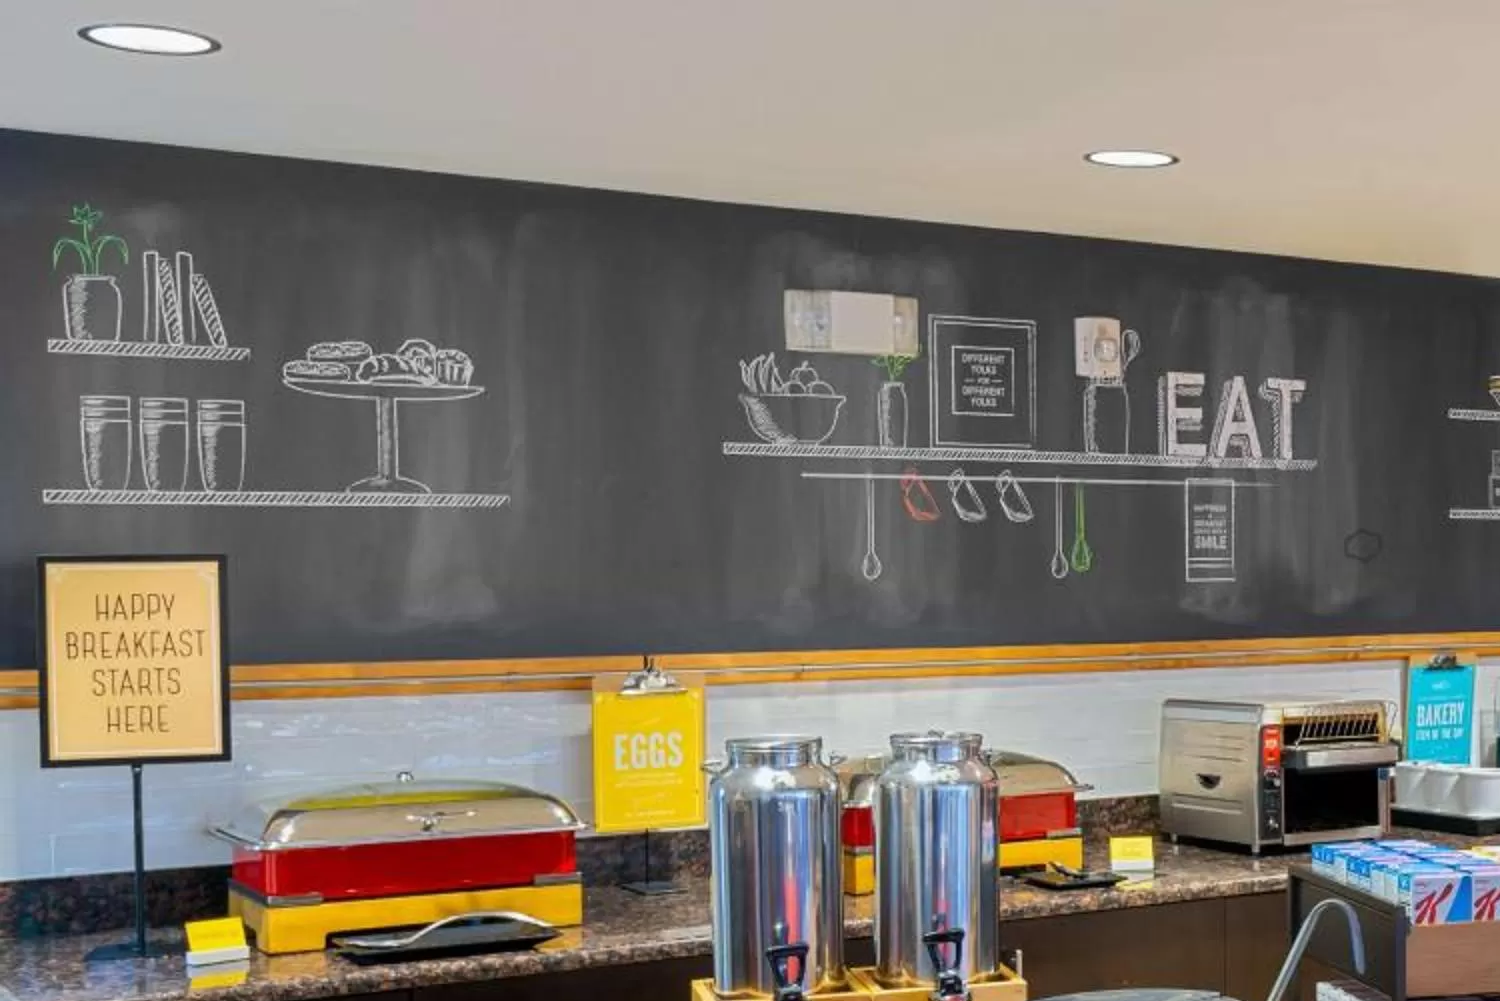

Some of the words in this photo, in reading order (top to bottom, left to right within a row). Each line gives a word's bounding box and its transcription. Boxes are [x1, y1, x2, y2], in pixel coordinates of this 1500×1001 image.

[1158, 371, 1307, 461] EAT
[95, 592, 175, 621] HAPPY
[65, 629, 206, 660] BREAKFAST
[92, 667, 181, 697] STARTS
[107, 704, 170, 733] HERE
[1416, 700, 1465, 727] BAKERY
[614, 731, 684, 770] EGGS
